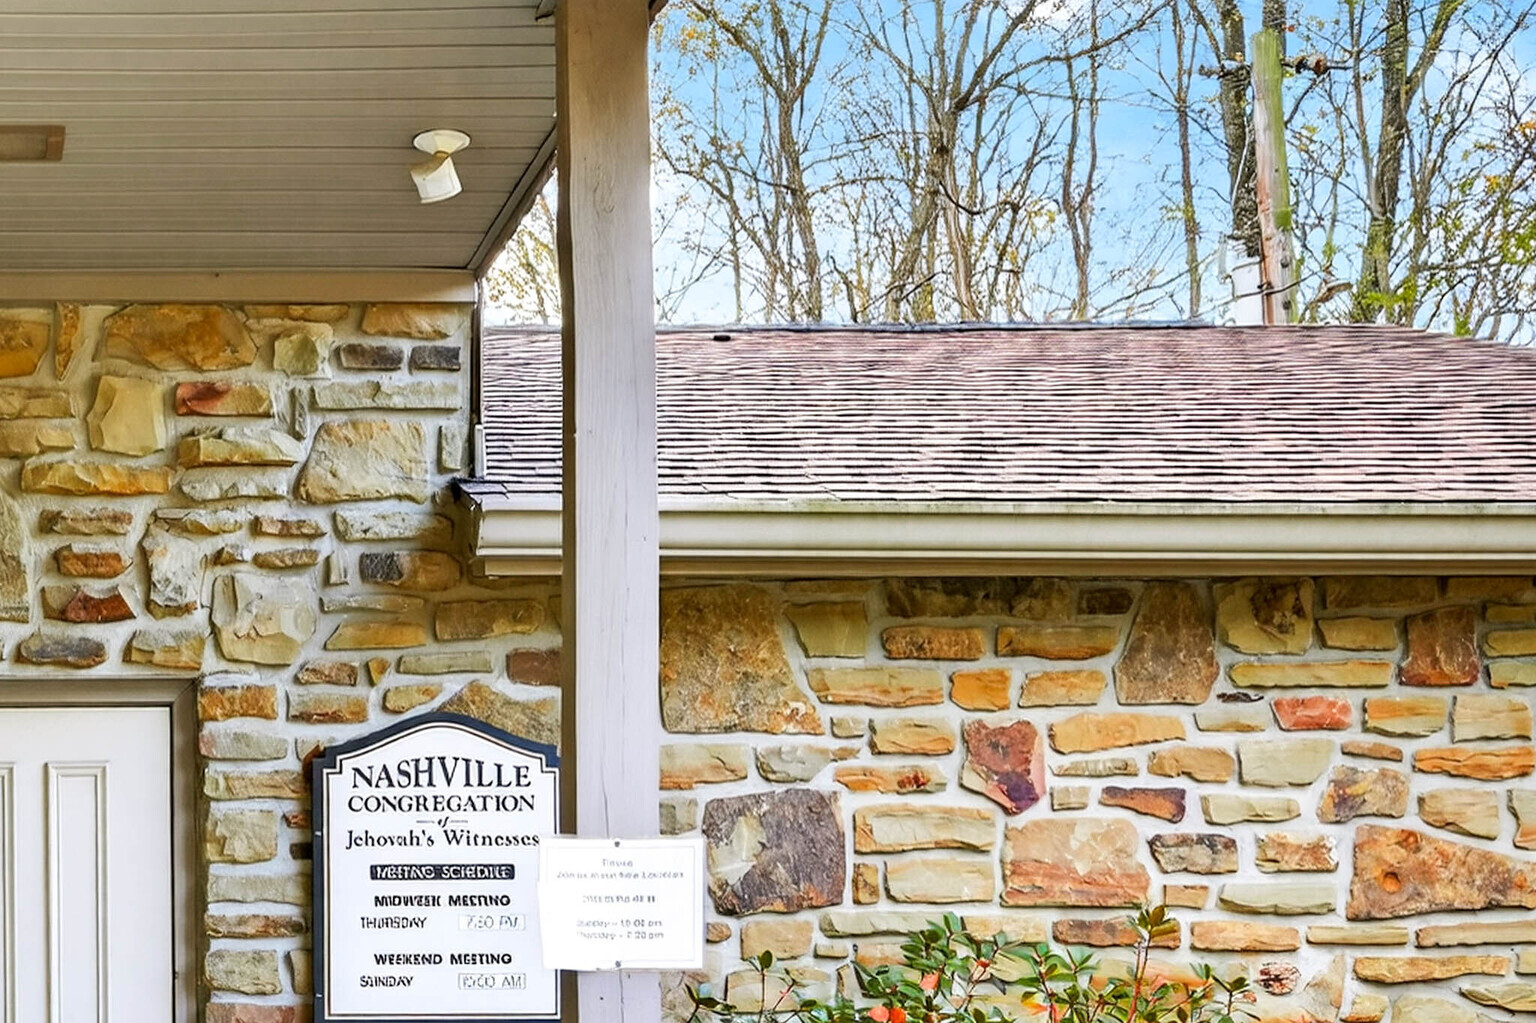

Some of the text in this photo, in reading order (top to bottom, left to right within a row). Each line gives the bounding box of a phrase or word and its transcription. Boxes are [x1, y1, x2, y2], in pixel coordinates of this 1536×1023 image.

[352, 756, 531, 788] NASHVILLE
[348, 795, 535, 812] CONGREGATION
[346, 829, 540, 850] Jehovah's Witnesses
[374, 895, 511, 907] MIDWEEK MEETING
[361, 916, 427, 929] THURSDAY
[374, 954, 512, 965] WEEKEND MEETING
[360, 975, 414, 987] SUNDAY
